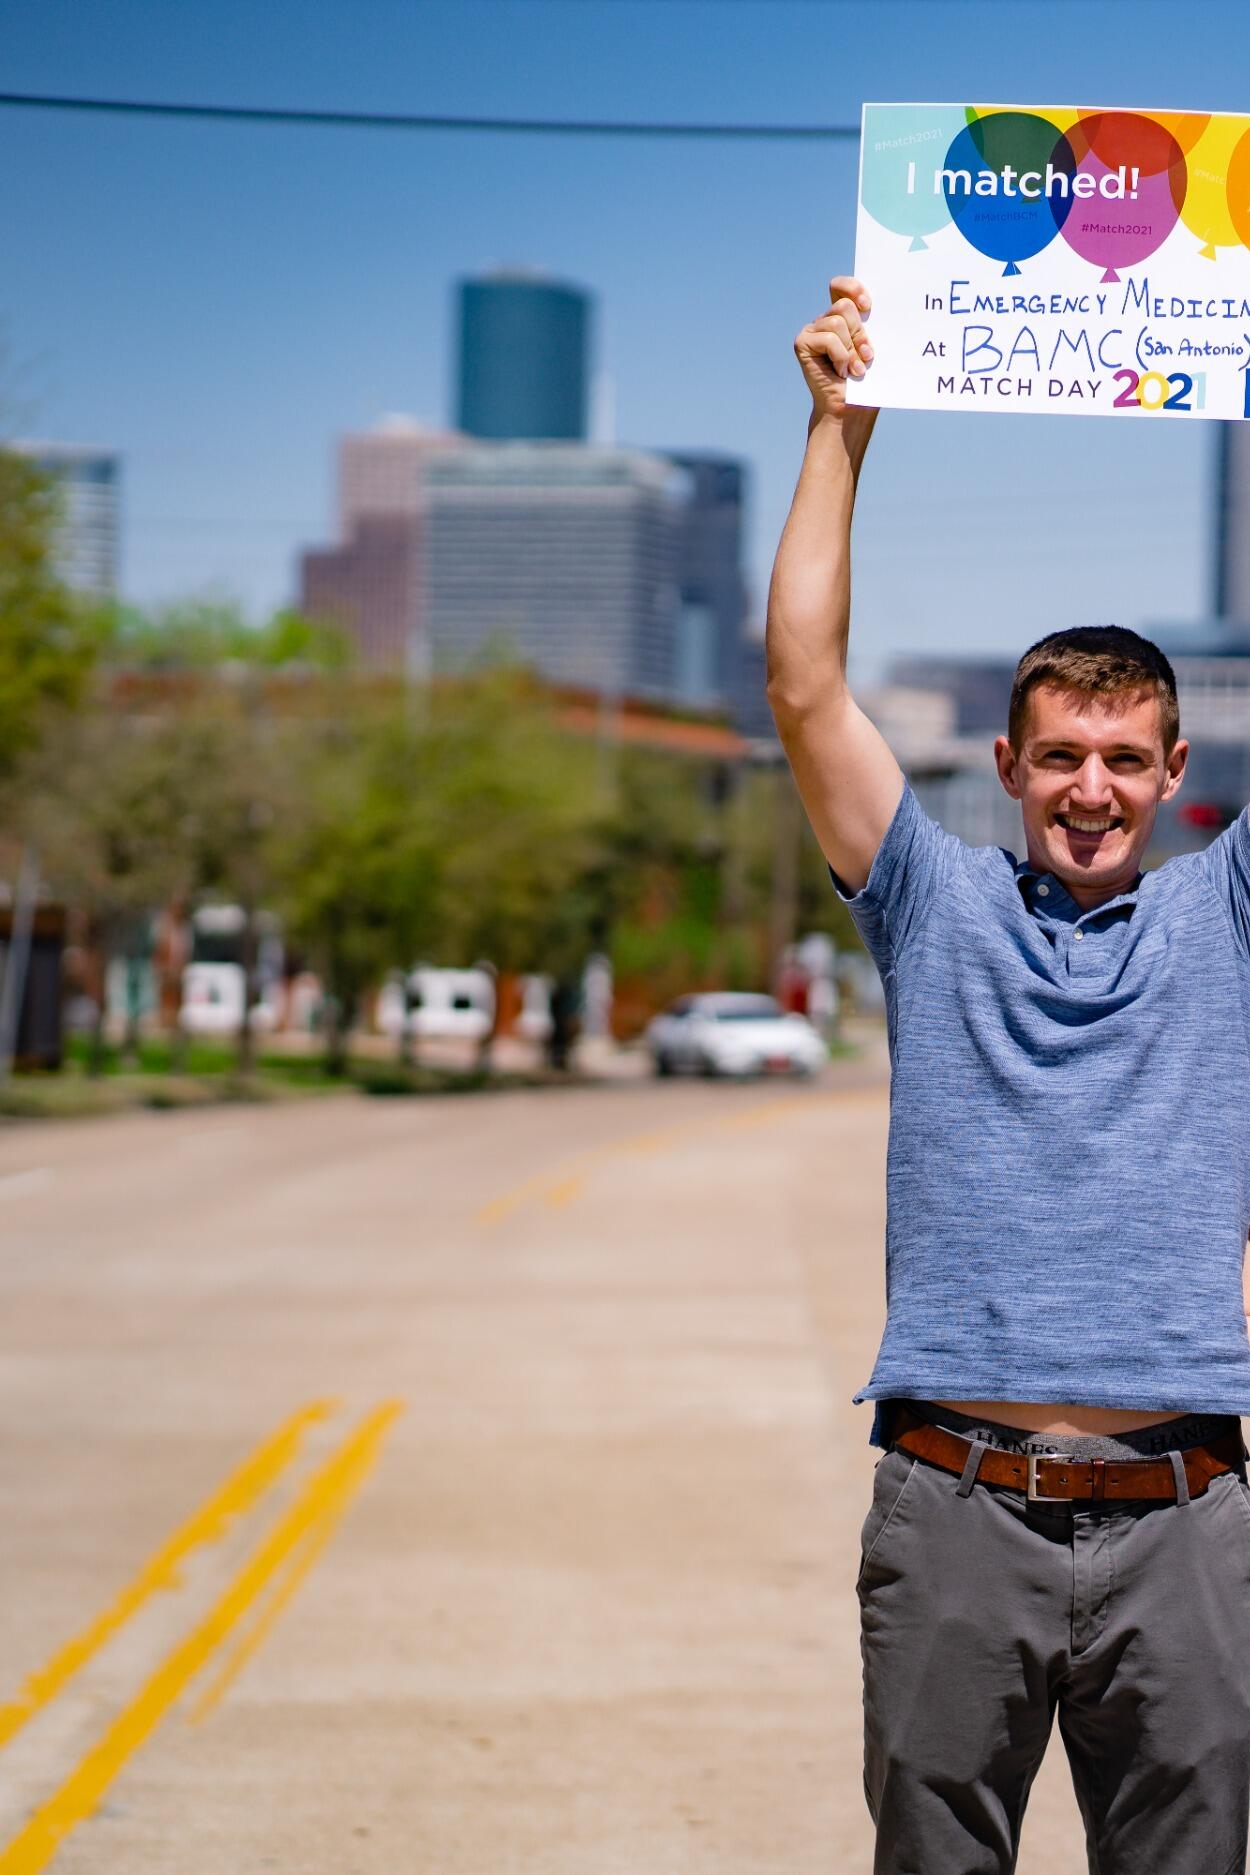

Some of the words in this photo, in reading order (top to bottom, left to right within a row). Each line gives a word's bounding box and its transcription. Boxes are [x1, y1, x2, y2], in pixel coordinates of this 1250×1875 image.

[874, 128, 944, 152] #Match2021
[907, 162, 916, 194] I
[934, 163, 1140, 200] matched!
[1081, 223, 1152, 235] #Match2021
[925, 294, 943, 311] In
[950, 280, 1107, 315] EMERGENCY
[922, 340, 946, 357] At
[962, 325, 1123, 374] BAMC
[1136, 326, 1173, 371] (San
[937, 376, 1032, 396] MATCH
[1048, 379, 1102, 399] DAY
[1112, 368, 1208, 411] 2021
